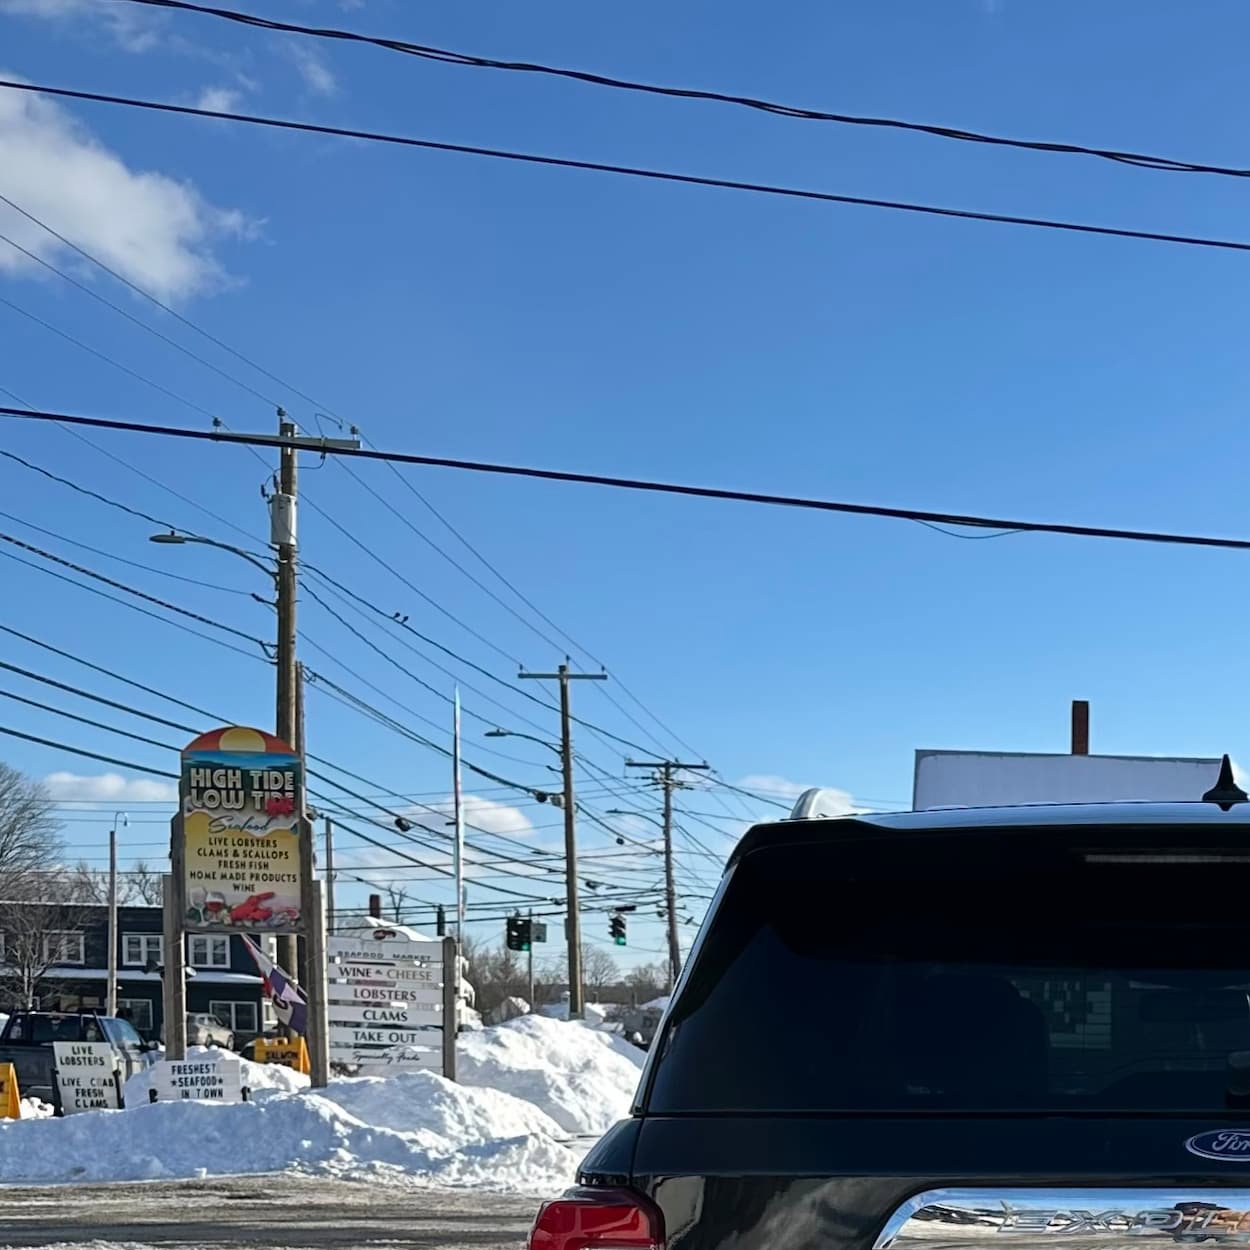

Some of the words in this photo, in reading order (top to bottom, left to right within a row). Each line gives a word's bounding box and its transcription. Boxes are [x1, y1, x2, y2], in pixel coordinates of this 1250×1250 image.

[190, 767, 242, 789] HIGH
[249, 770, 294, 791] TIDE
[191, 788, 245, 810] LOW
[208, 837, 228, 846] LIVE
[231, 838, 278, 849] LOBSTERS
[197, 848, 229, 858] CLAMS
[232, 849, 239, 858] &
[242, 850, 289, 860] SCALLOPS
[218, 860, 246, 870] FRESH
[249, 861, 270, 870] FISH
[189, 871, 217, 881] HOME
[220, 872, 246, 881] MADE
[250, 873, 297, 883] PRODUCTS
[232, 882, 256, 893] WINE
[338, 966, 372, 978] WINE
[386, 968, 433, 981] CHEESE
[353, 988, 417, 1001] LOBSTERS
[362, 1009, 408, 1022] CLAMS
[352, 1031, 384, 1043] TAKE
[388, 1032, 417, 1044] OUT
[72, 1045, 93, 1055] LIVE
[60, 1056, 105, 1066] LOBSTERS
[171, 1063, 216, 1075] FRESHEST
[62, 1078, 81, 1087] LIVE
[90, 1078, 114, 1088] CAB
[178, 1076, 217, 1087] SEAFOOD
[75, 1088, 104, 1098] FRESH
[181, 1089, 190, 1099] IN
[196, 1088, 223, 1098] TOWN
[75, 1099, 108, 1109] CLAMS
